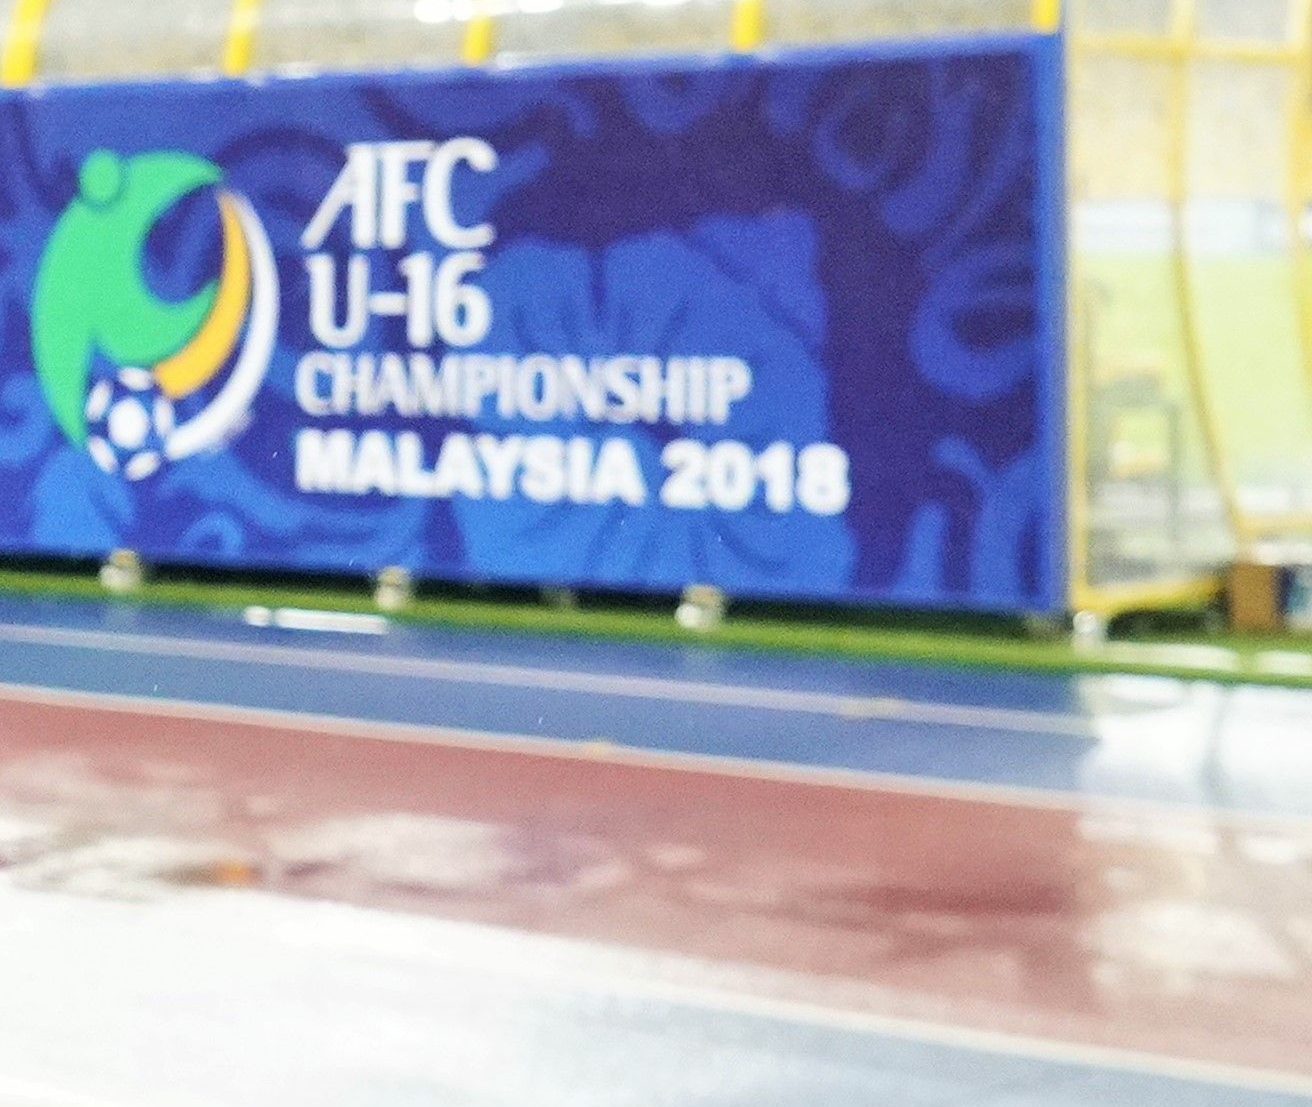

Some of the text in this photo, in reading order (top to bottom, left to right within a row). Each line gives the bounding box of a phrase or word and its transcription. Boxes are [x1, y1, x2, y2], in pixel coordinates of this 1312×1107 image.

[301, 137, 498, 250] AFC
[305, 251, 494, 348] U-16
[295, 351, 753, 425] CHAMPIONSHIP
[294, 428, 851, 515] MALAYSIA 2018
